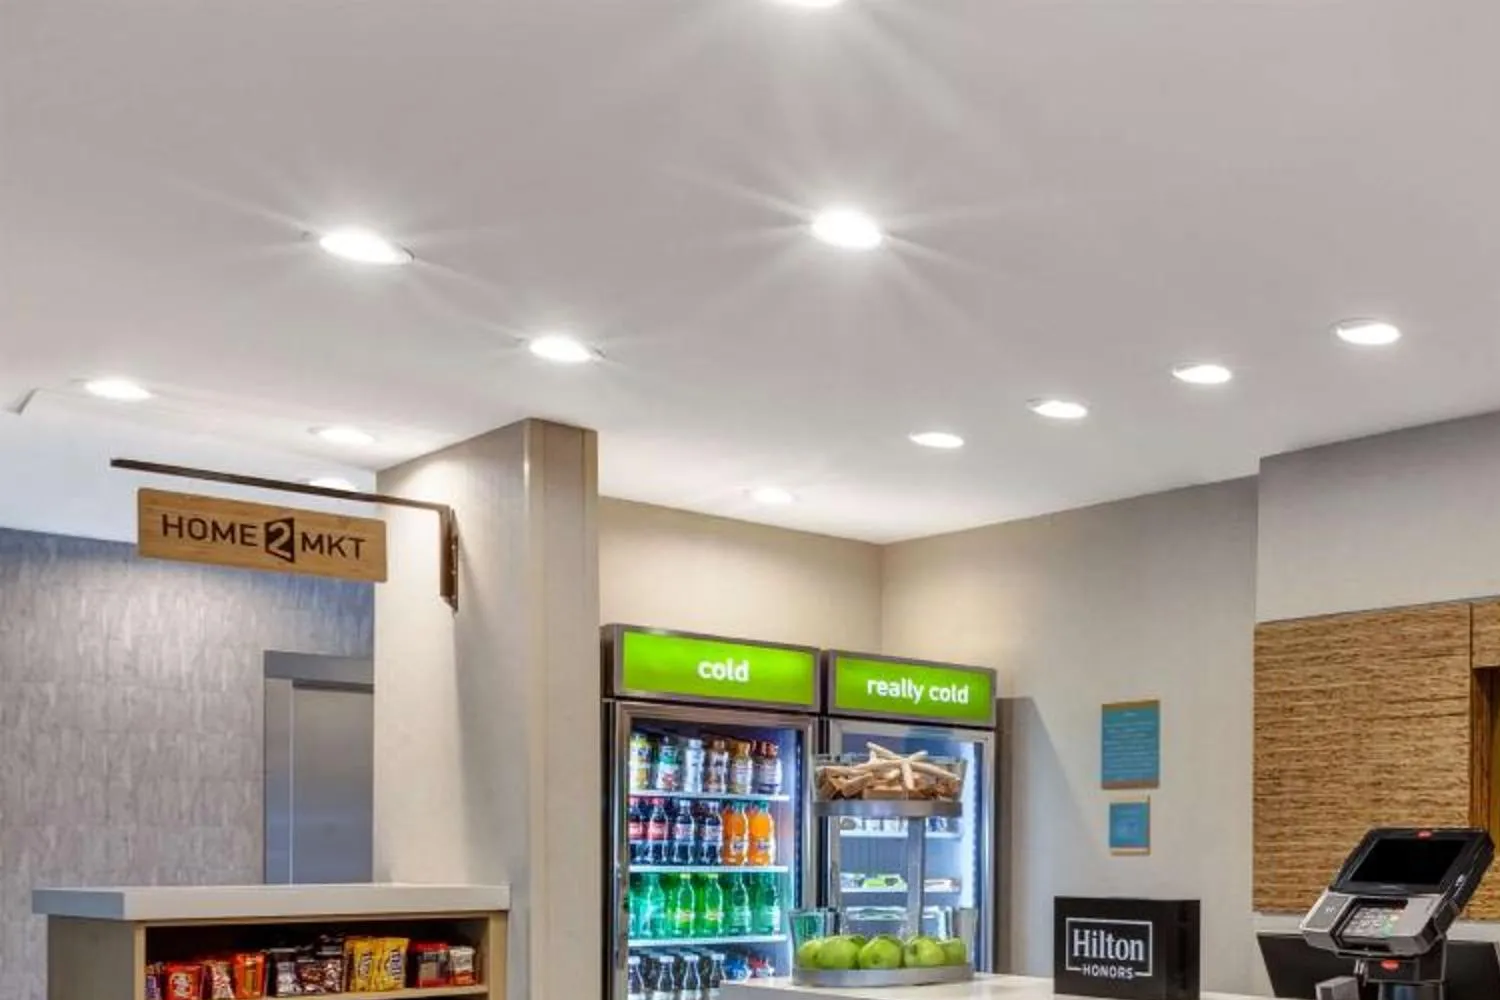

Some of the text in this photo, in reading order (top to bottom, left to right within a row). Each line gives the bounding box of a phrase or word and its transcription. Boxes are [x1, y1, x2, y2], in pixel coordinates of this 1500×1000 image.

[161, 513, 257, 547] HOME
[301, 531, 365, 560] MKT
[697, 658, 750, 682] cold
[866, 677, 970, 705] really cold
[1073, 929, 1145, 961] Hilton
[1083, 964, 1134, 980] HONORS
